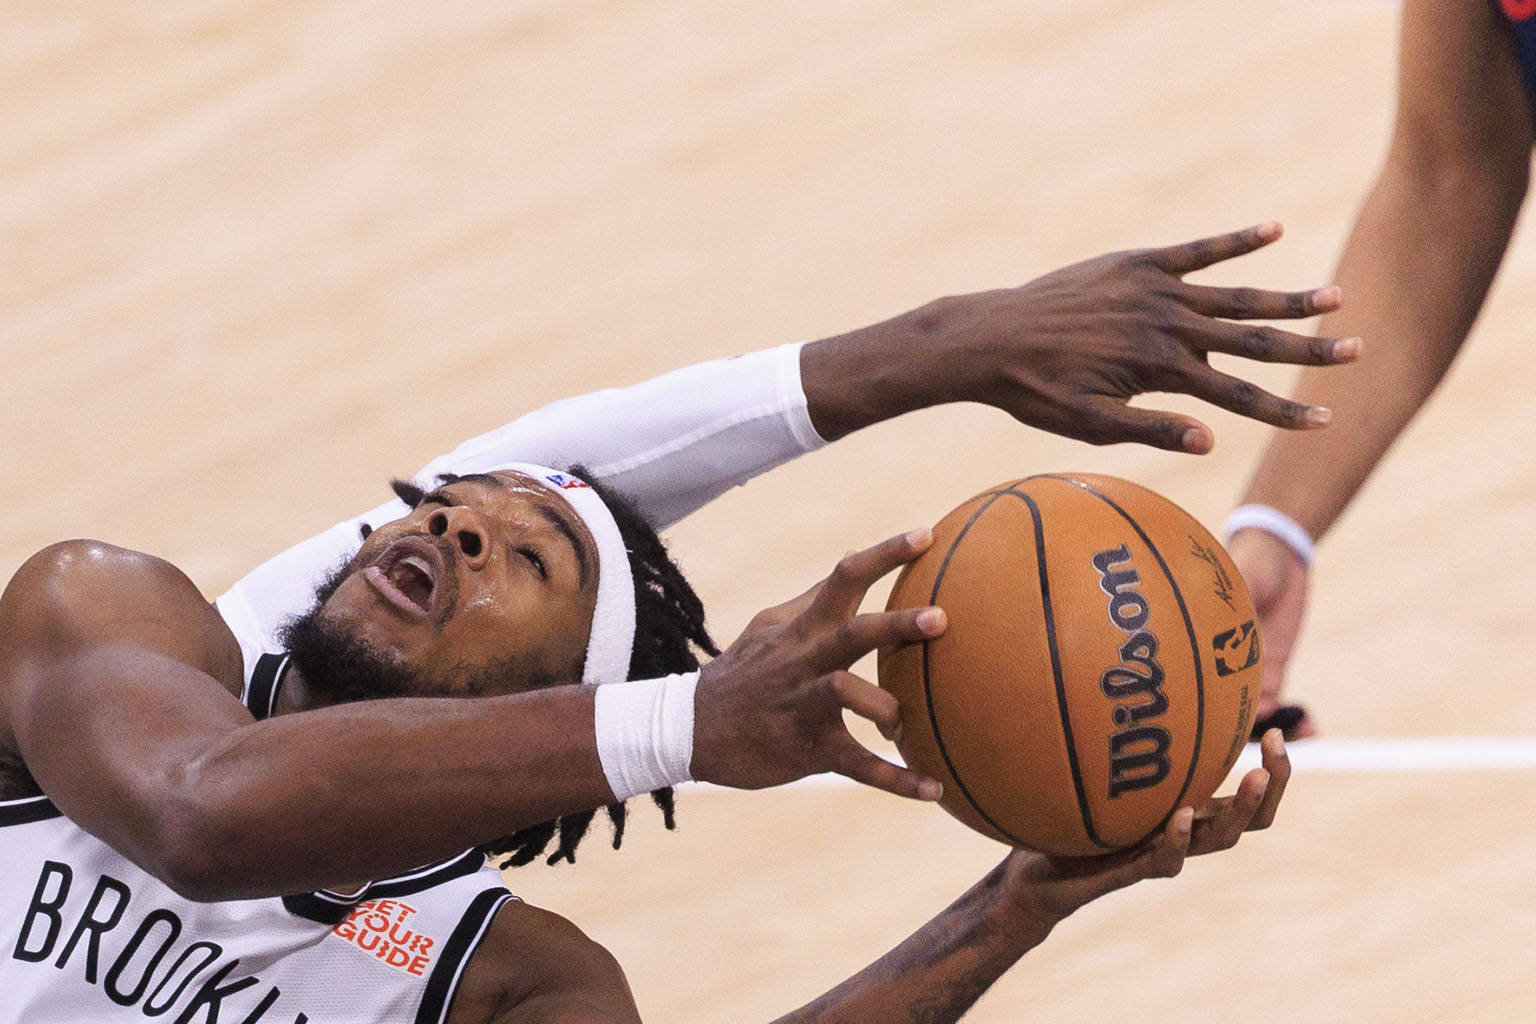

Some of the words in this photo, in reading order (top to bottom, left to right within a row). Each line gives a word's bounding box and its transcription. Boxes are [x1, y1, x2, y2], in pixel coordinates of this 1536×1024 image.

[1091, 542, 1173, 800] Wilson
[332, 919, 430, 977] GUIDE
[348, 906, 434, 956] YOUR
